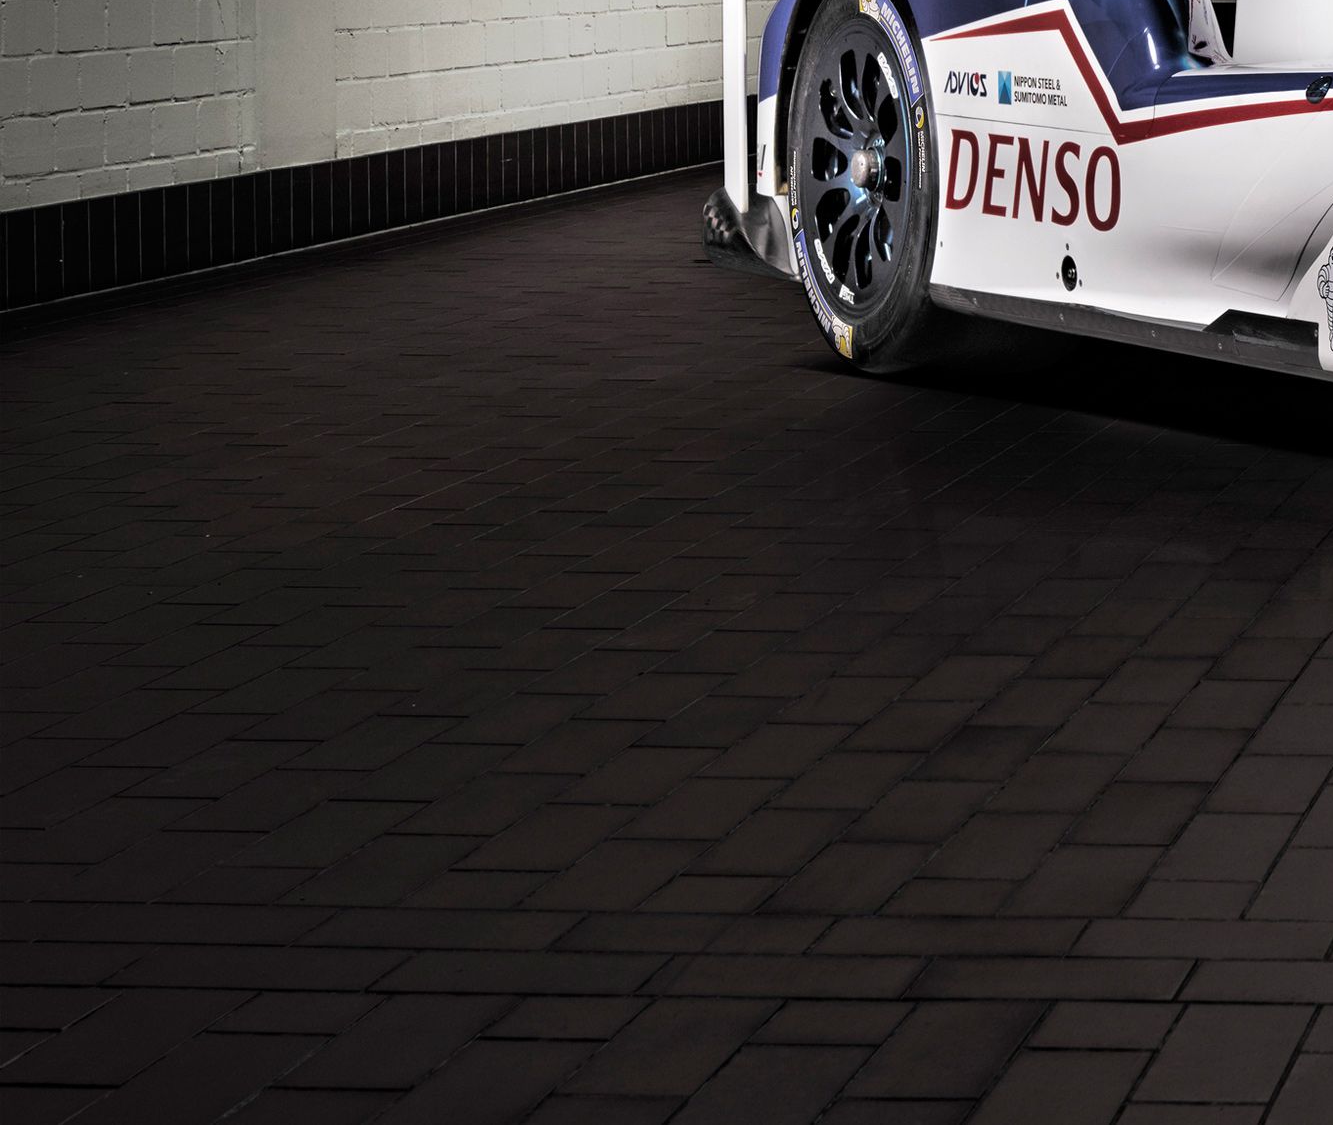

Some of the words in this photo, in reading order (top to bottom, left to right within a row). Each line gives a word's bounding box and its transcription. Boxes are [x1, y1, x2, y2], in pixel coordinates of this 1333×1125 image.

[881, 2, 920, 94] MICHELIN
[944, 71, 987, 97] ADVICS
[1014, 76, 1037, 89] NIPPON
[1038, 78, 1056, 90] STEEL
[1056, 79, 1061, 90] &
[1014, 92, 1047, 105] SUMITOMO
[1048, 94, 1067, 107] METAL
[945, 128, 1121, 232] DENSO
